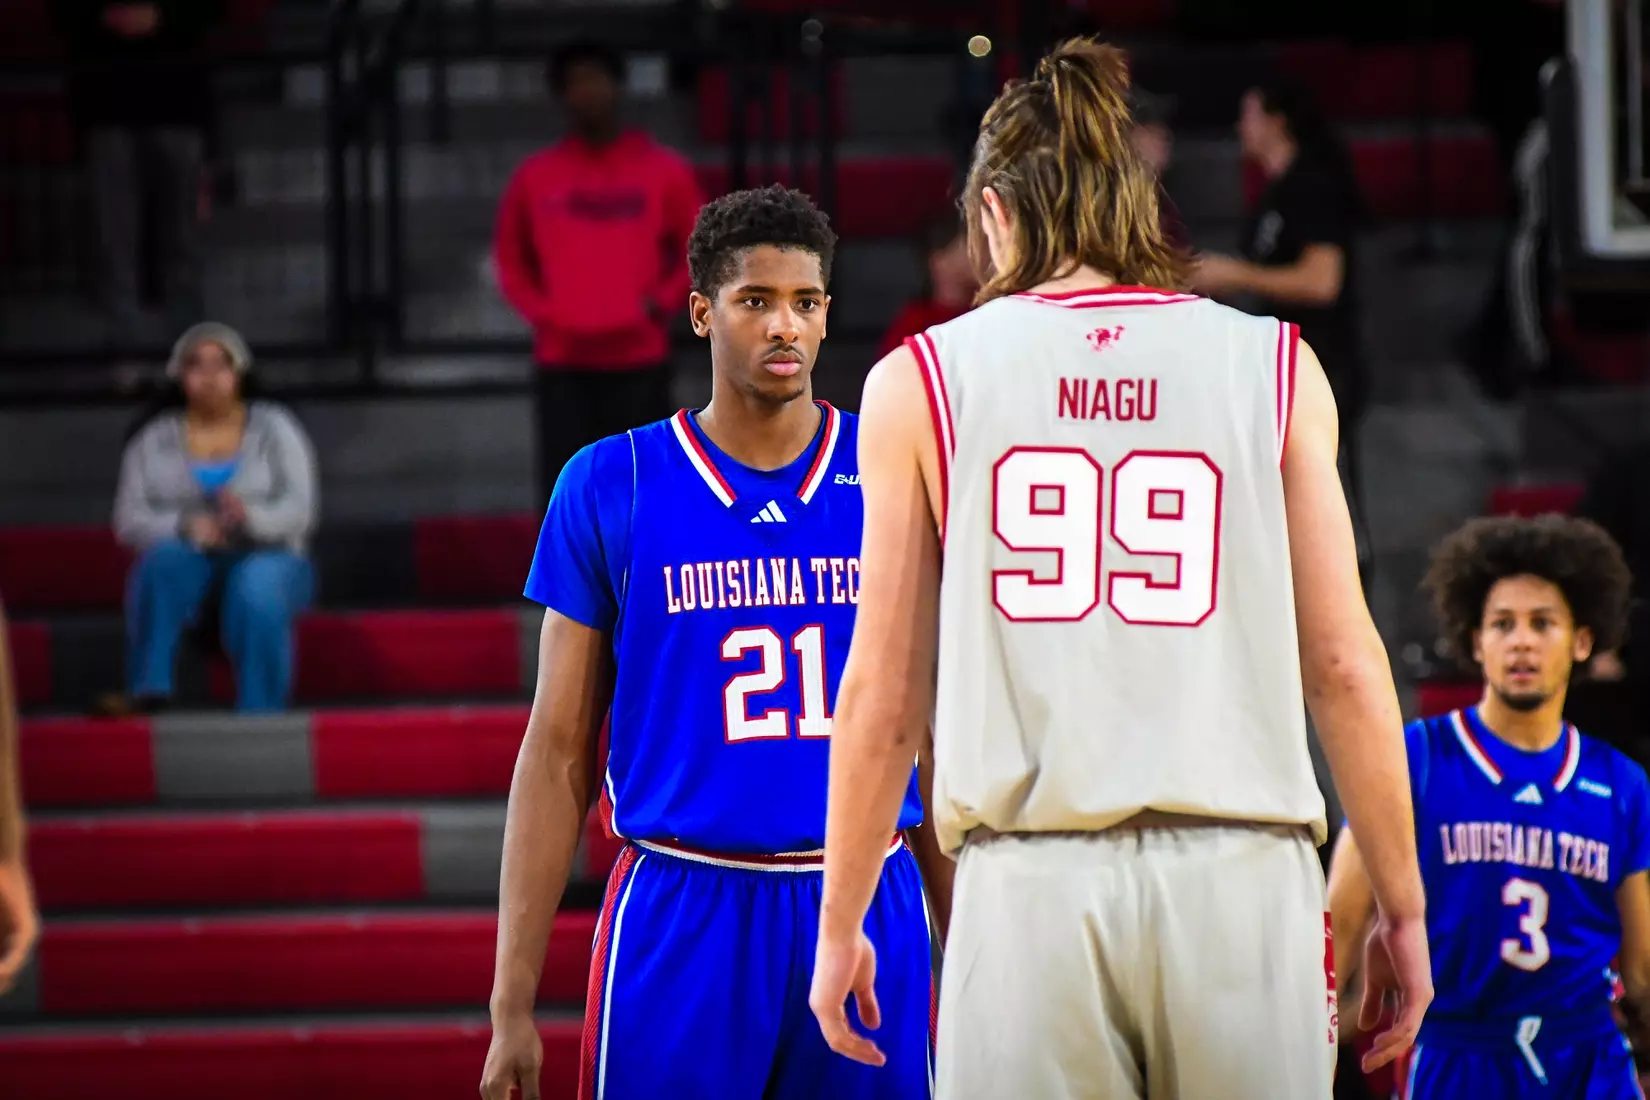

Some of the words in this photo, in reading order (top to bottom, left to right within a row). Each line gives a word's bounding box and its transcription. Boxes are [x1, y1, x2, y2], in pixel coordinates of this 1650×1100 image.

[1058, 376, 1158, 422] NIAGU
[991, 445, 1224, 628] 99
[663, 557, 806, 614] LOUISIANA
[810, 556, 861, 605] TEC
[719, 623, 834, 745] 21
[1439, 821, 1555, 870] LOUISIANA
[1557, 831, 1610, 884] TECH
[1500, 876, 1551, 973] 3
